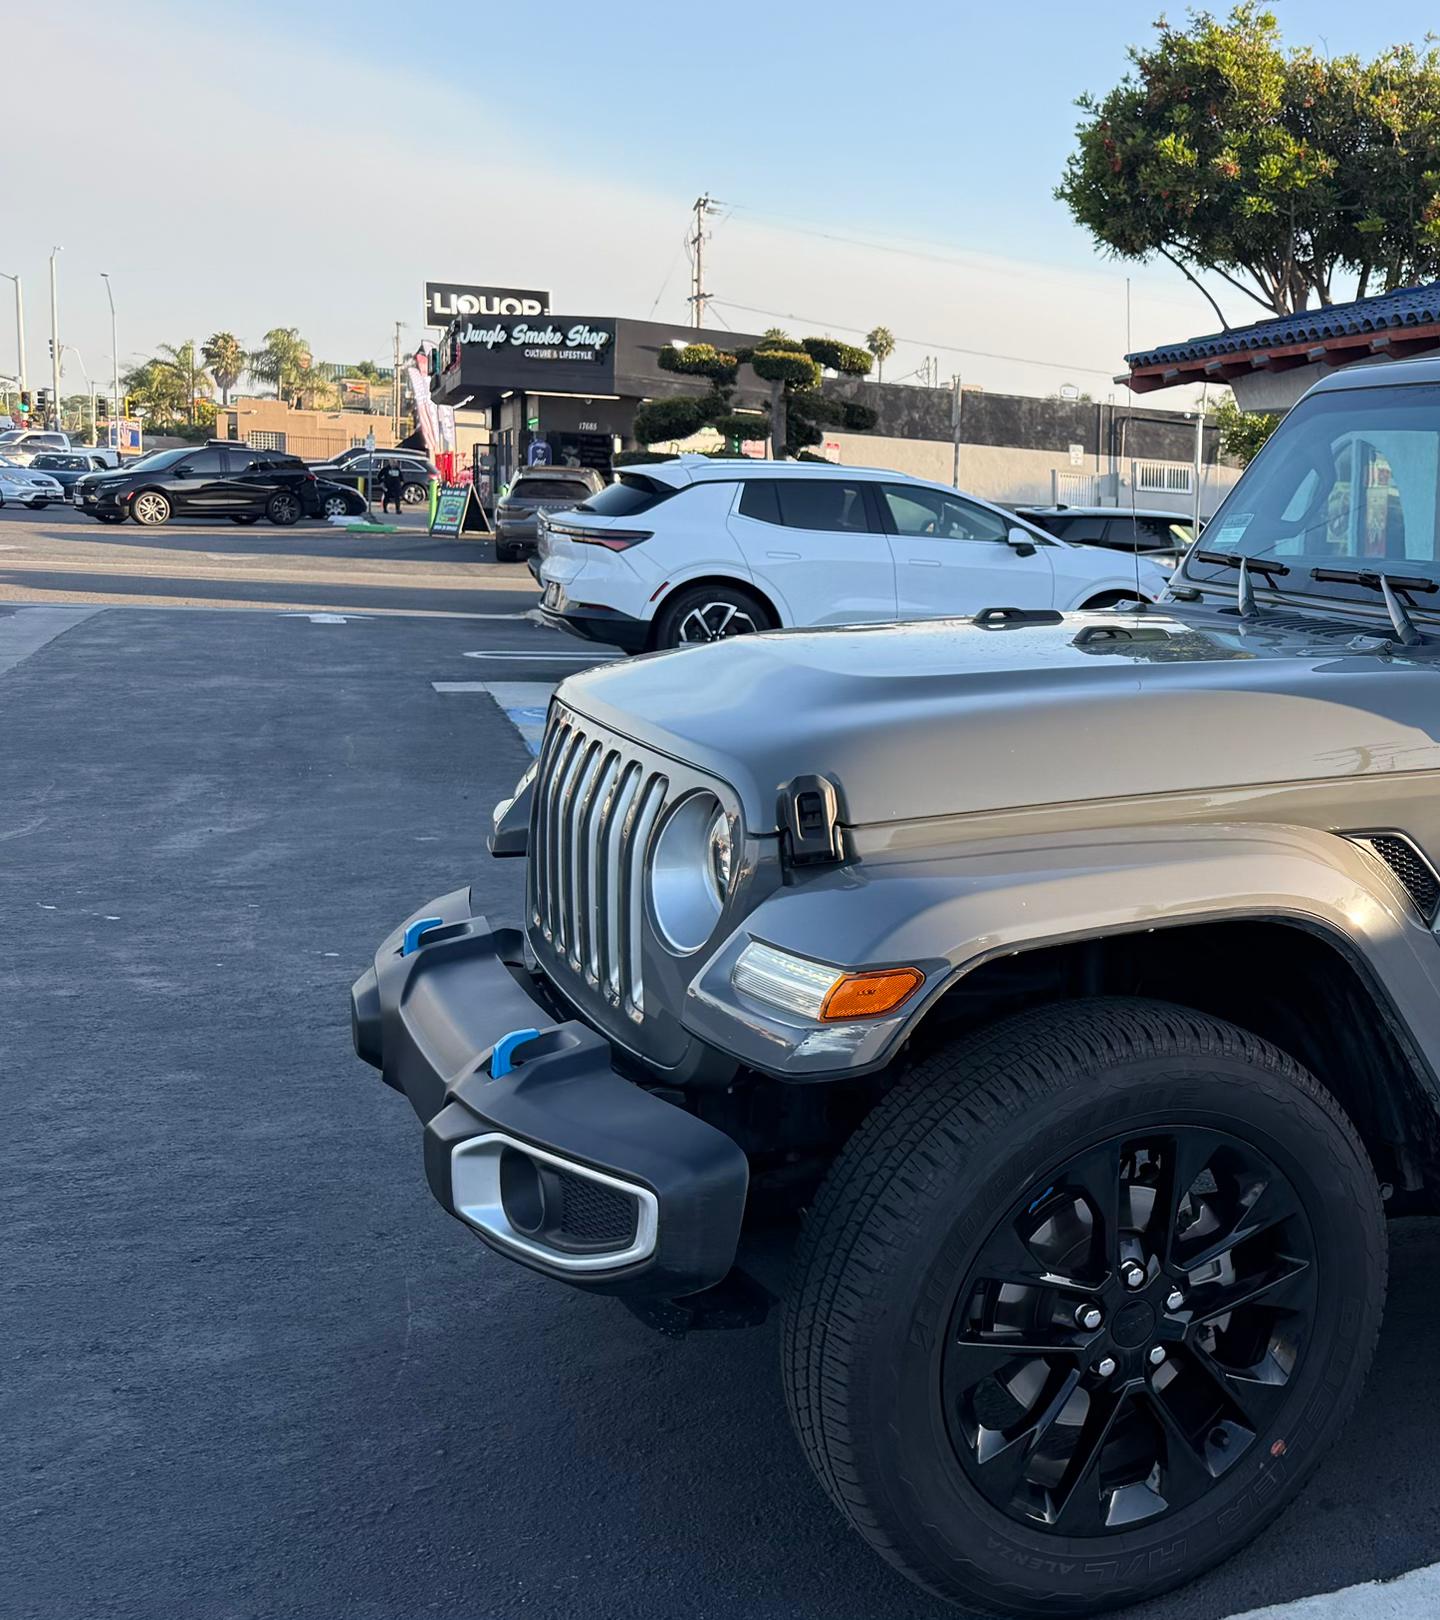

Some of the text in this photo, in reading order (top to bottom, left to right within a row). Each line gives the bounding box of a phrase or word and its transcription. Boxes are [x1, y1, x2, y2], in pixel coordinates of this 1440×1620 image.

[433, 292, 542, 316] LIQUOR
[459, 322, 609, 350] Jungle Smoke Shop
[524, 349, 551, 358] CULTURE
[558, 350, 593, 360] LIFESTYLE
[986, 1534, 1077, 1577] ALENZA
